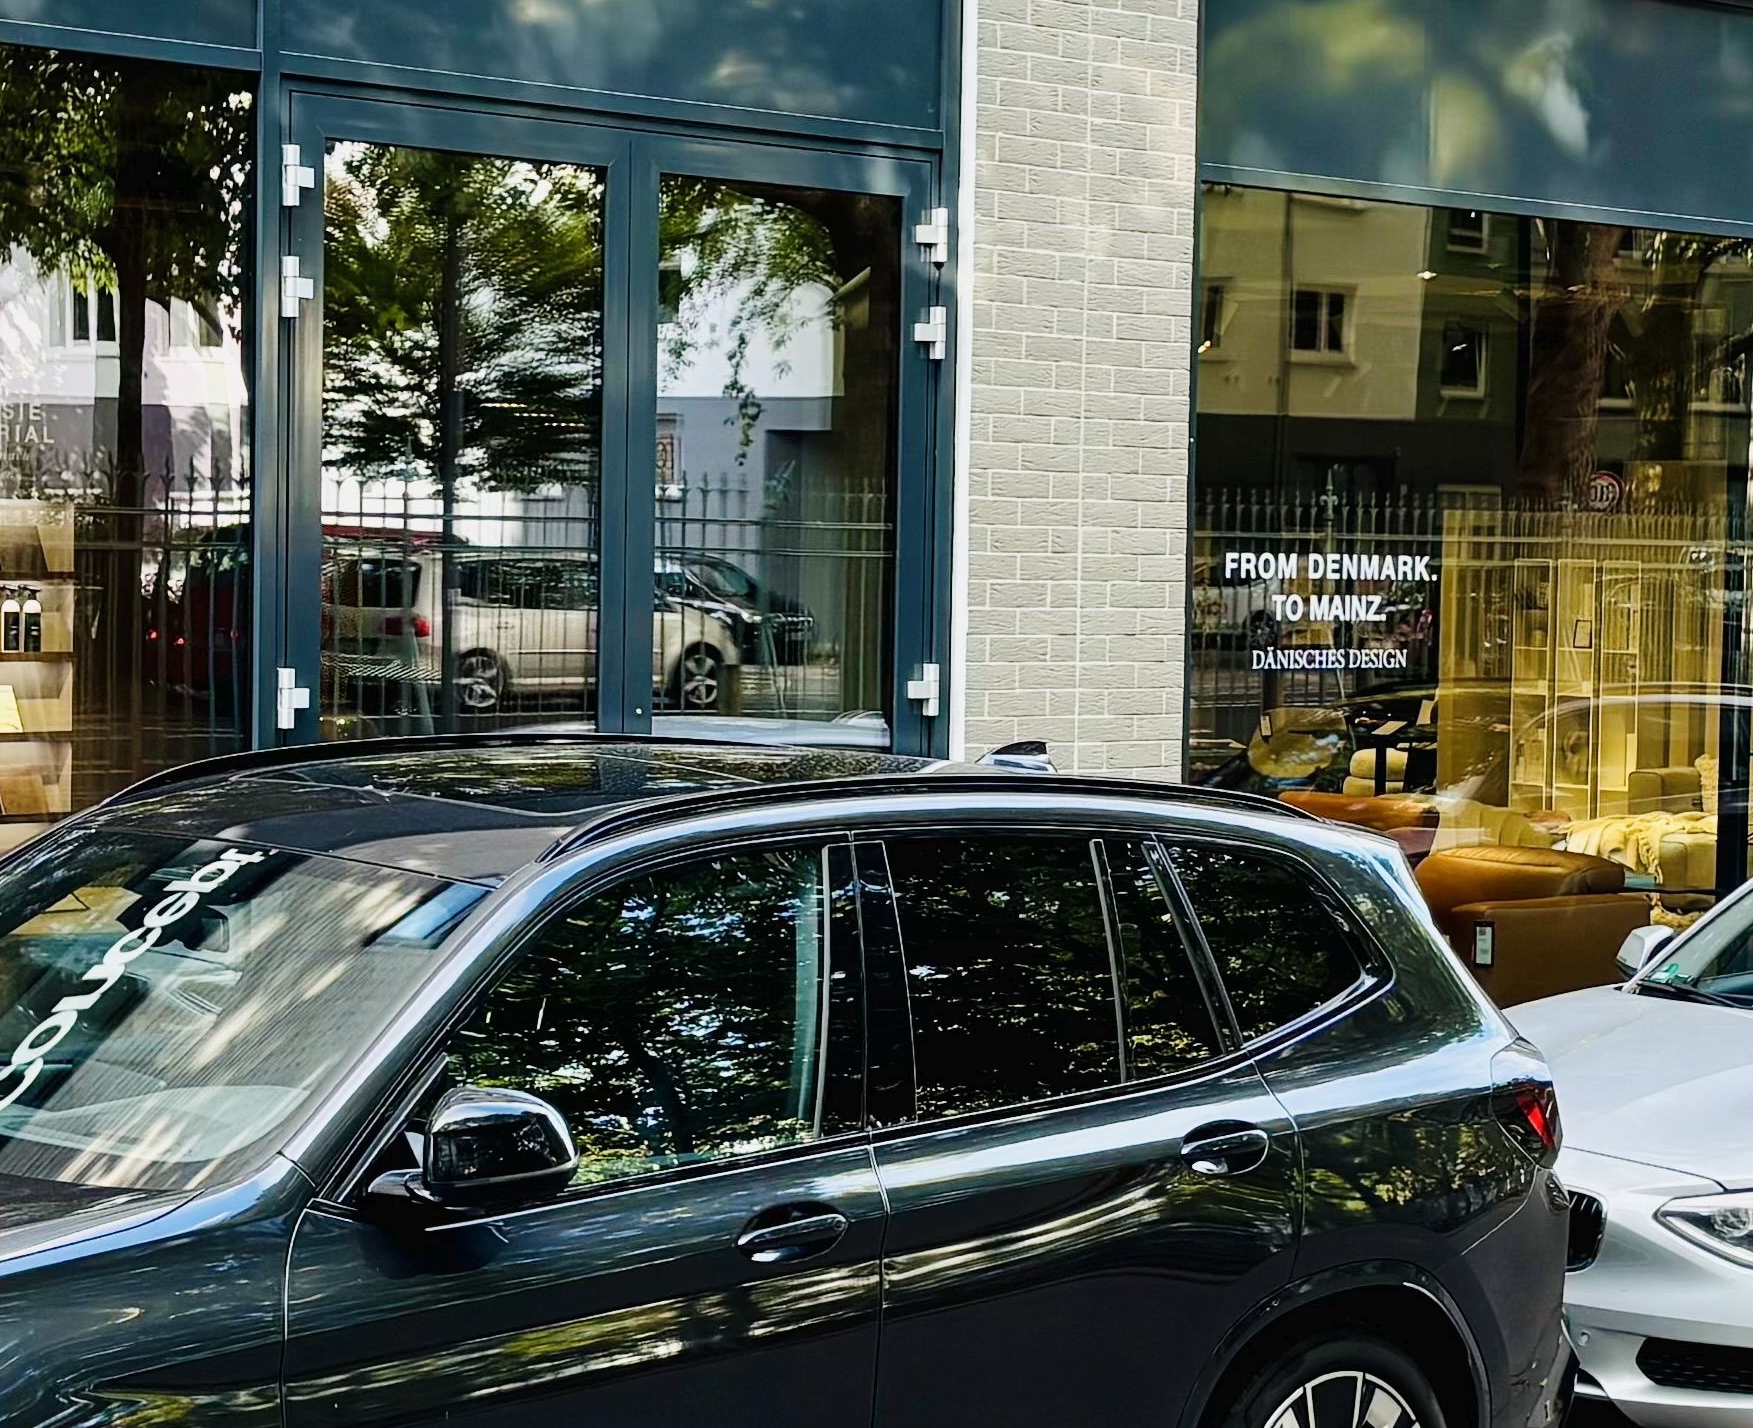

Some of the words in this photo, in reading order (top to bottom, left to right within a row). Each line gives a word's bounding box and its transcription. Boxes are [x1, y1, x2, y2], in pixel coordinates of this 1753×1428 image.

[1224, 551, 1298, 580] FROM
[1307, 553, 1439, 582] DENMARK.
[1270, 594, 1304, 622] TO
[1309, 594, 1387, 622] MAINZ.
[1251, 646, 1346, 671] DÄNISCHES
[1347, 648, 1408, 670] DESIGN
